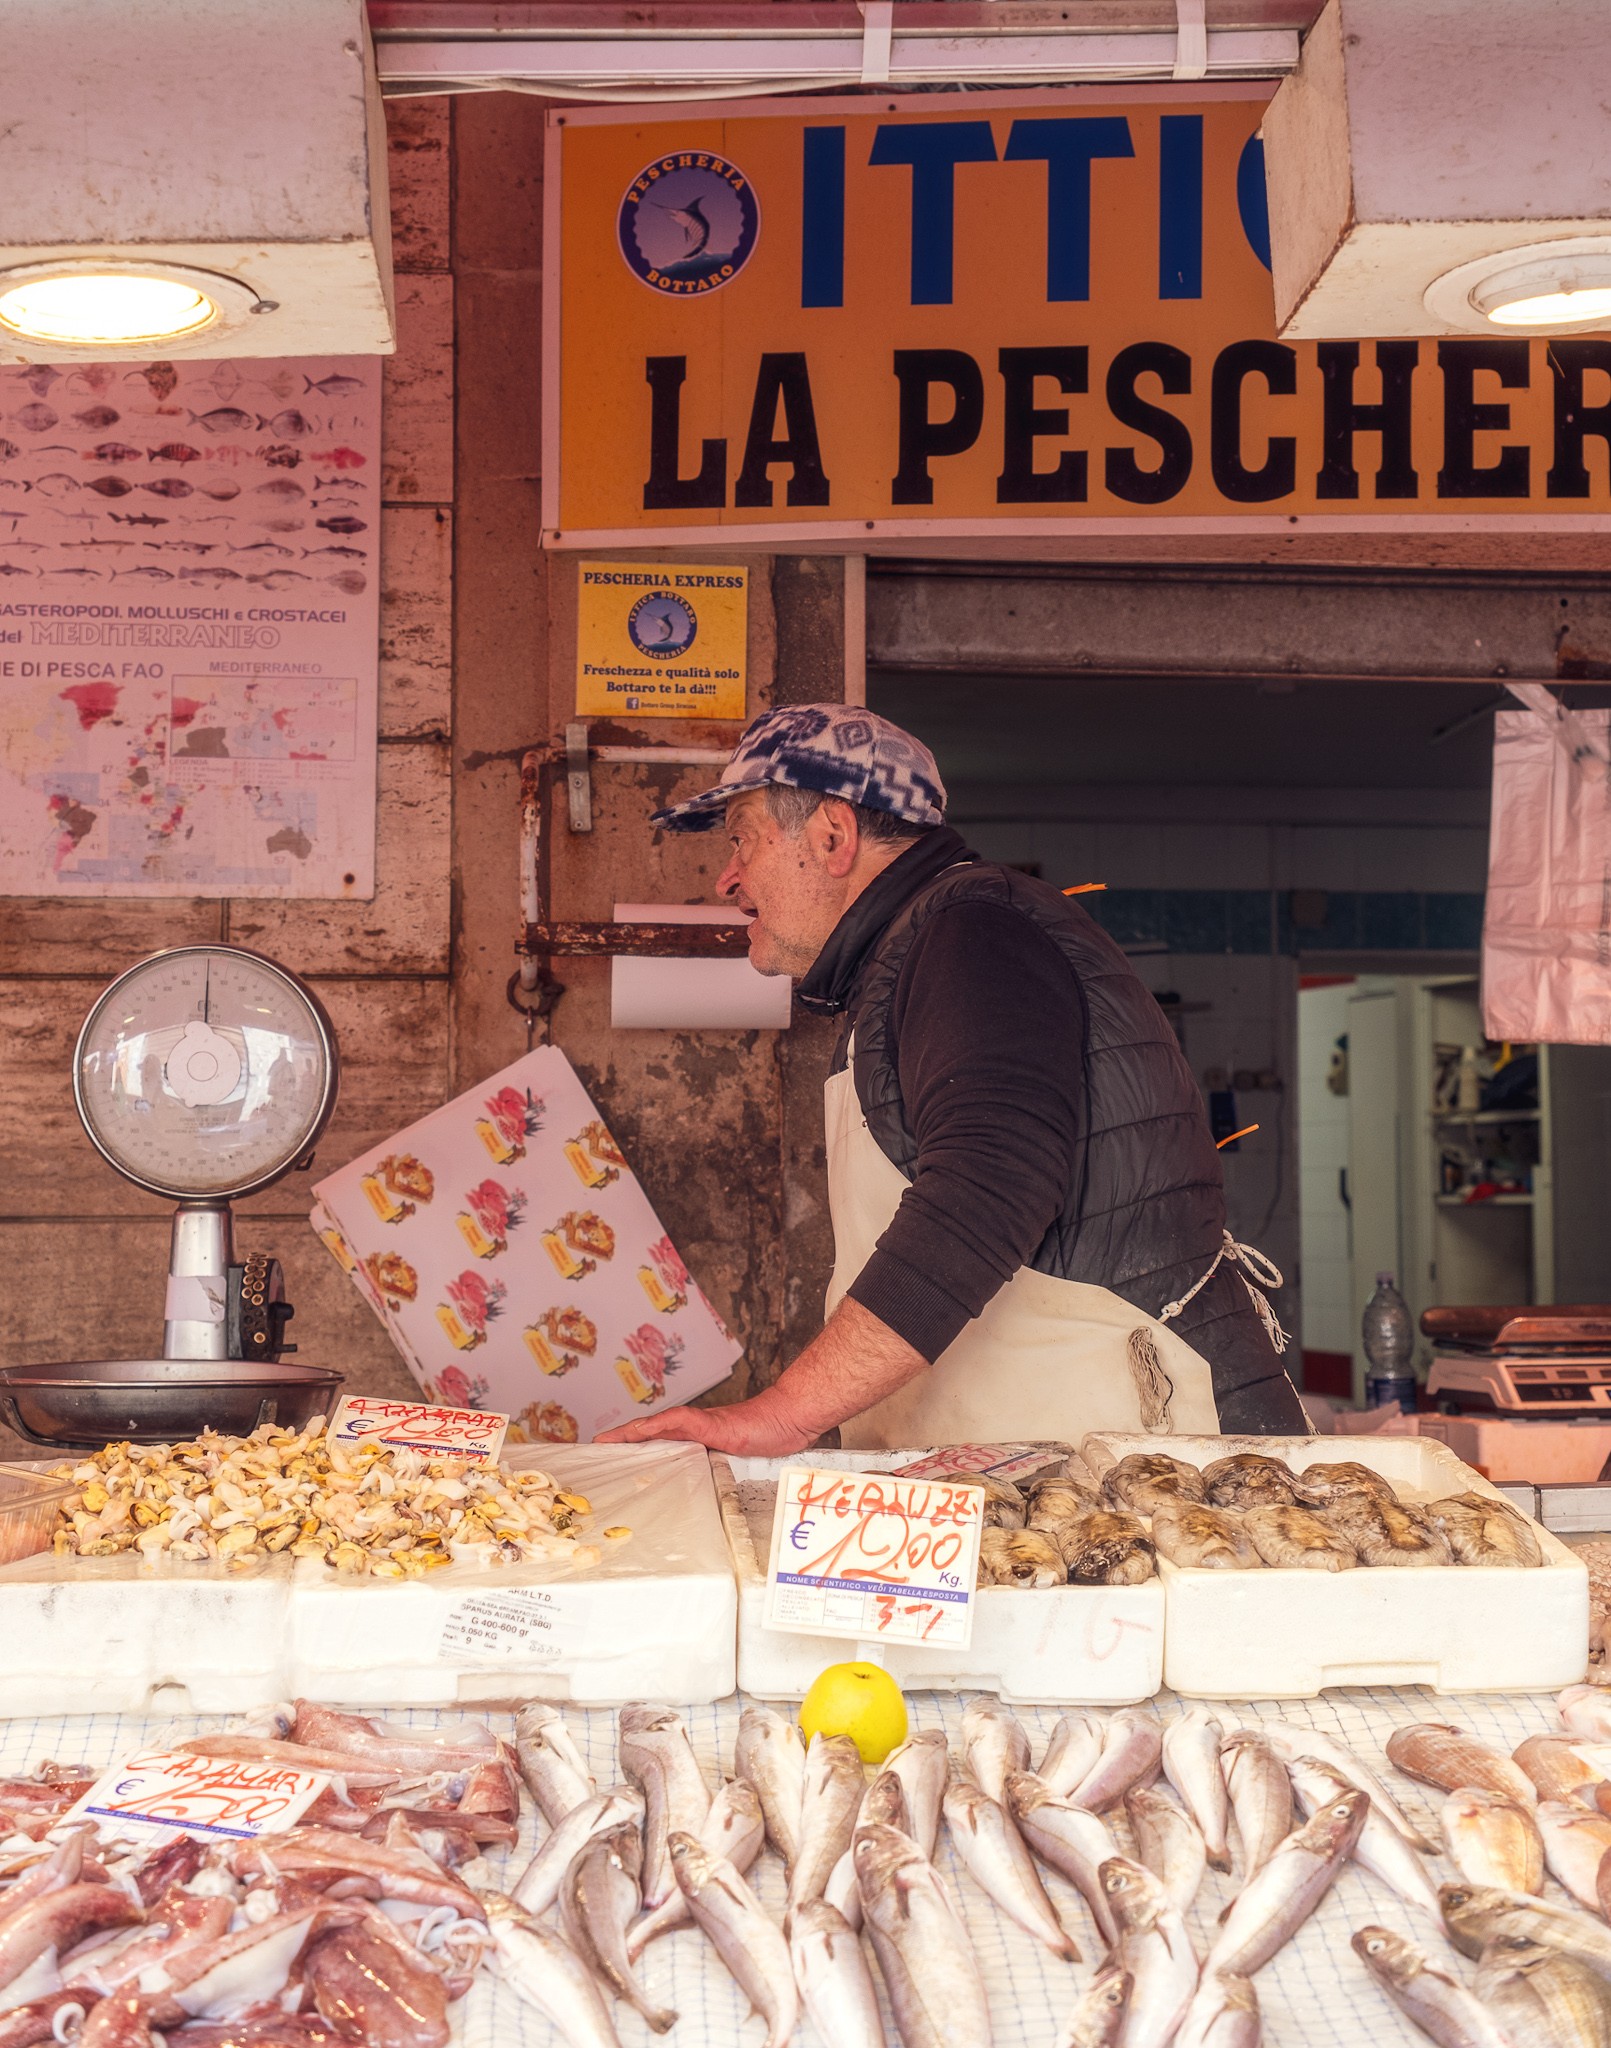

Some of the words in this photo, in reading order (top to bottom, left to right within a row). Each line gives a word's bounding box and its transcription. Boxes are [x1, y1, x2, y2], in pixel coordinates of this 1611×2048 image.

[628, 155, 745, 203] PESCHERIA
[646, 265, 733, 292] BOTTARO
[643, 352, 830, 509] LA
[892, 339, 1611, 505] PESCHER
[584, 572, 671, 586] PESCHERIA
[675, 575, 743, 588] EXPRESS
[128, 606, 230, 620] MOLLUSCHI
[247, 609, 346, 623] CROSTACEI
[630, 594, 655, 622] ITTICA
[661, 592, 696, 623] BOTTARO
[29, 621, 281, 649] MEDITERRANEO
[638, 643, 686, 659] PESCHERIA
[21, 662, 40, 678] DI
[47, 662, 115, 679] PESCA
[121, 663, 164, 679] FAO
[209, 661, 322, 675] MEDITERRANEO
[583, 664, 652, 677] Freschezza
[656, 669, 662, 677] e
[666, 667, 711, 679] qualità
[714, 669, 740, 679] solo
[606, 682, 655, 693] Bottaro
[660, 684, 672, 693] te
[675, 684, 686, 694] la
[689, 684, 716, 695] dà!!!
[345, 1419, 374, 1434] €
[790, 1520, 815, 1550] €
[939, 1571, 963, 1587] Kg.
[786, 1576, 809, 1585] NOME
[810, 1578, 861, 1590] SCIENTIFICO
[866, 1583, 886, 1593] VEDI
[887, 1586, 921, 1597] TABELLA
[922, 1590, 959, 1601] ESPOSTA
[461, 1603, 492, 1616] SPARUS
[494, 1611, 525, 1624] AURATA
[529, 1618, 552, 1630] (SBG)
[461, 1625, 483, 1637] 5.050
[485, 1631, 498, 1640] KG
[471, 1616, 479, 1625] G
[481, 1619, 517, 1634] 400-600
[519, 1628, 529, 1638] gr
[465, 1636, 472, 1645] 9
[115, 1779, 145, 1796] €
